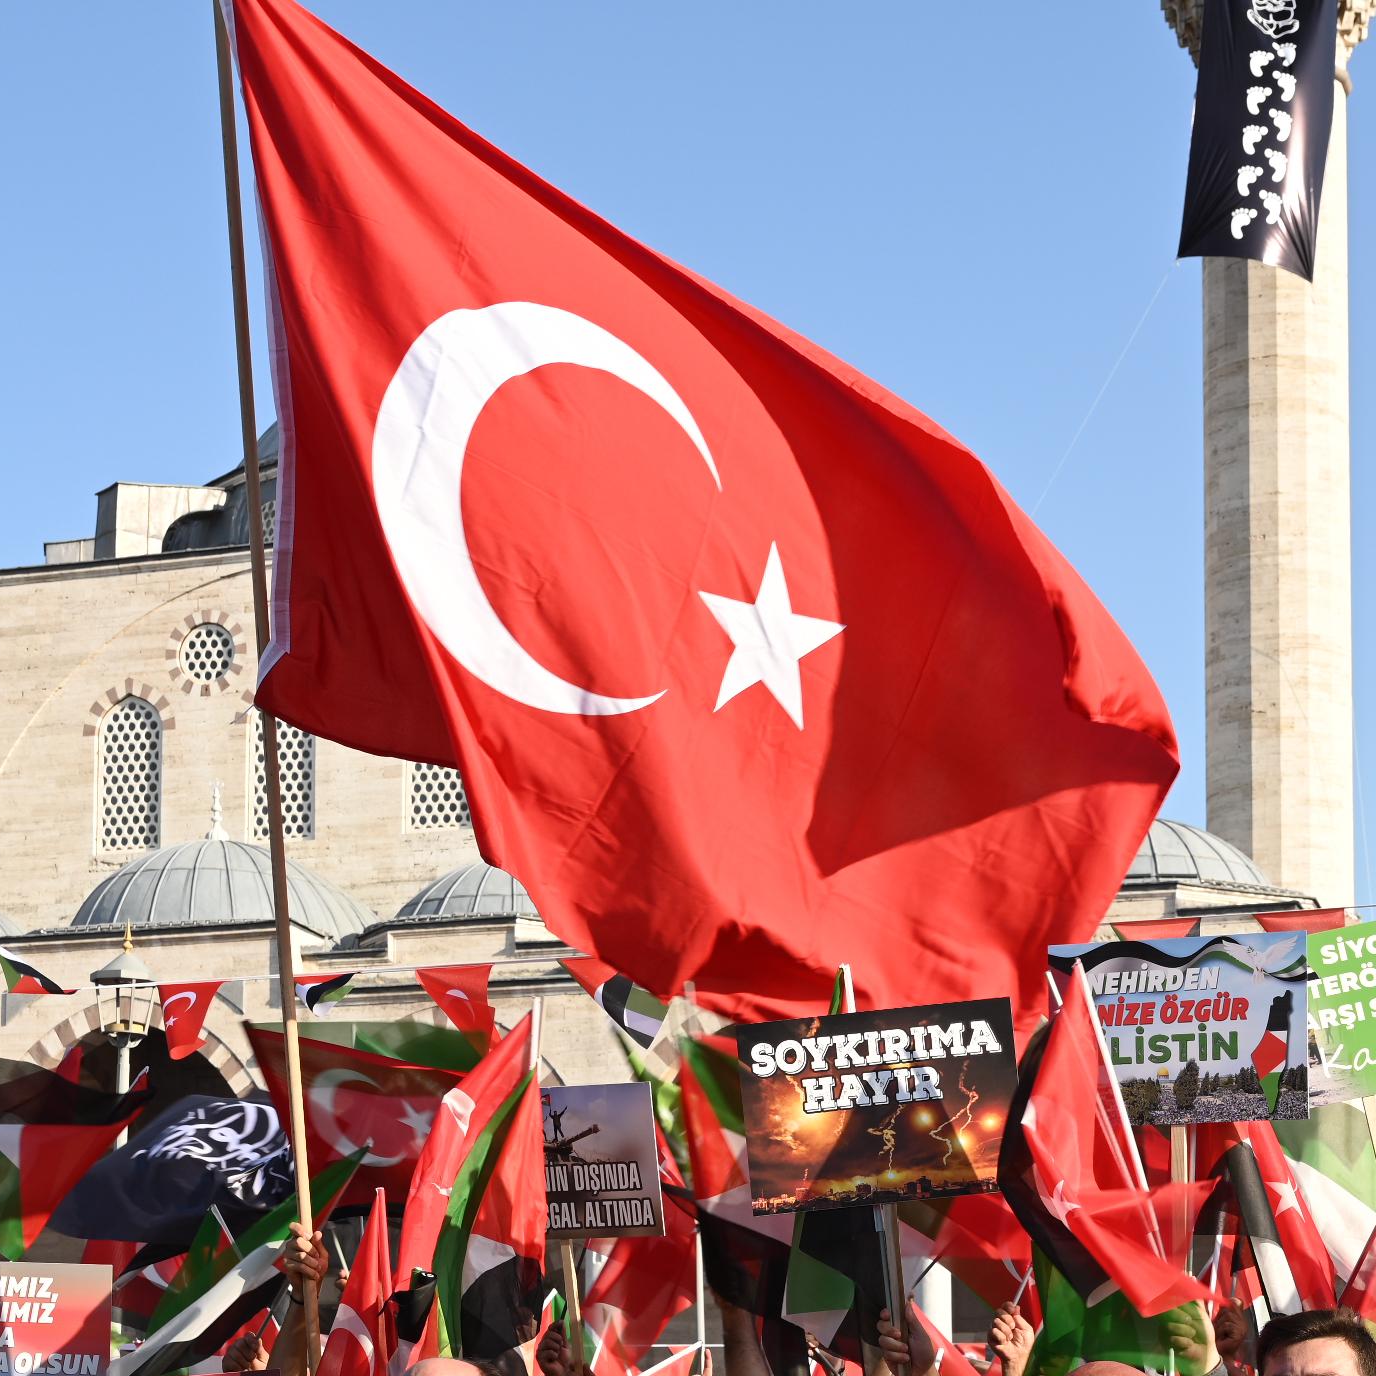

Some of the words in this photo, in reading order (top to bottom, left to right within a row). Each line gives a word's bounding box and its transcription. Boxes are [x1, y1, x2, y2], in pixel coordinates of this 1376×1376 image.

[1088, 962, 1221, 995] NEHİRDEN
[1096, 996, 1157, 1026] NİZE
[1159, 992, 1250, 1024] ÖZGÜR
[1307, 1002, 1366, 1031] ARŞI
[750, 1020, 1002, 1078] SOYKIRIMA
[1103, 1023, 1239, 1065] LİSTİN
[802, 1066, 943, 1113] HAYIR
[573, 1162, 641, 1195] DIŞINDA
[586, 1199, 655, 1227] ALTINDA
[14, 1352, 101, 1376] OLSUN
